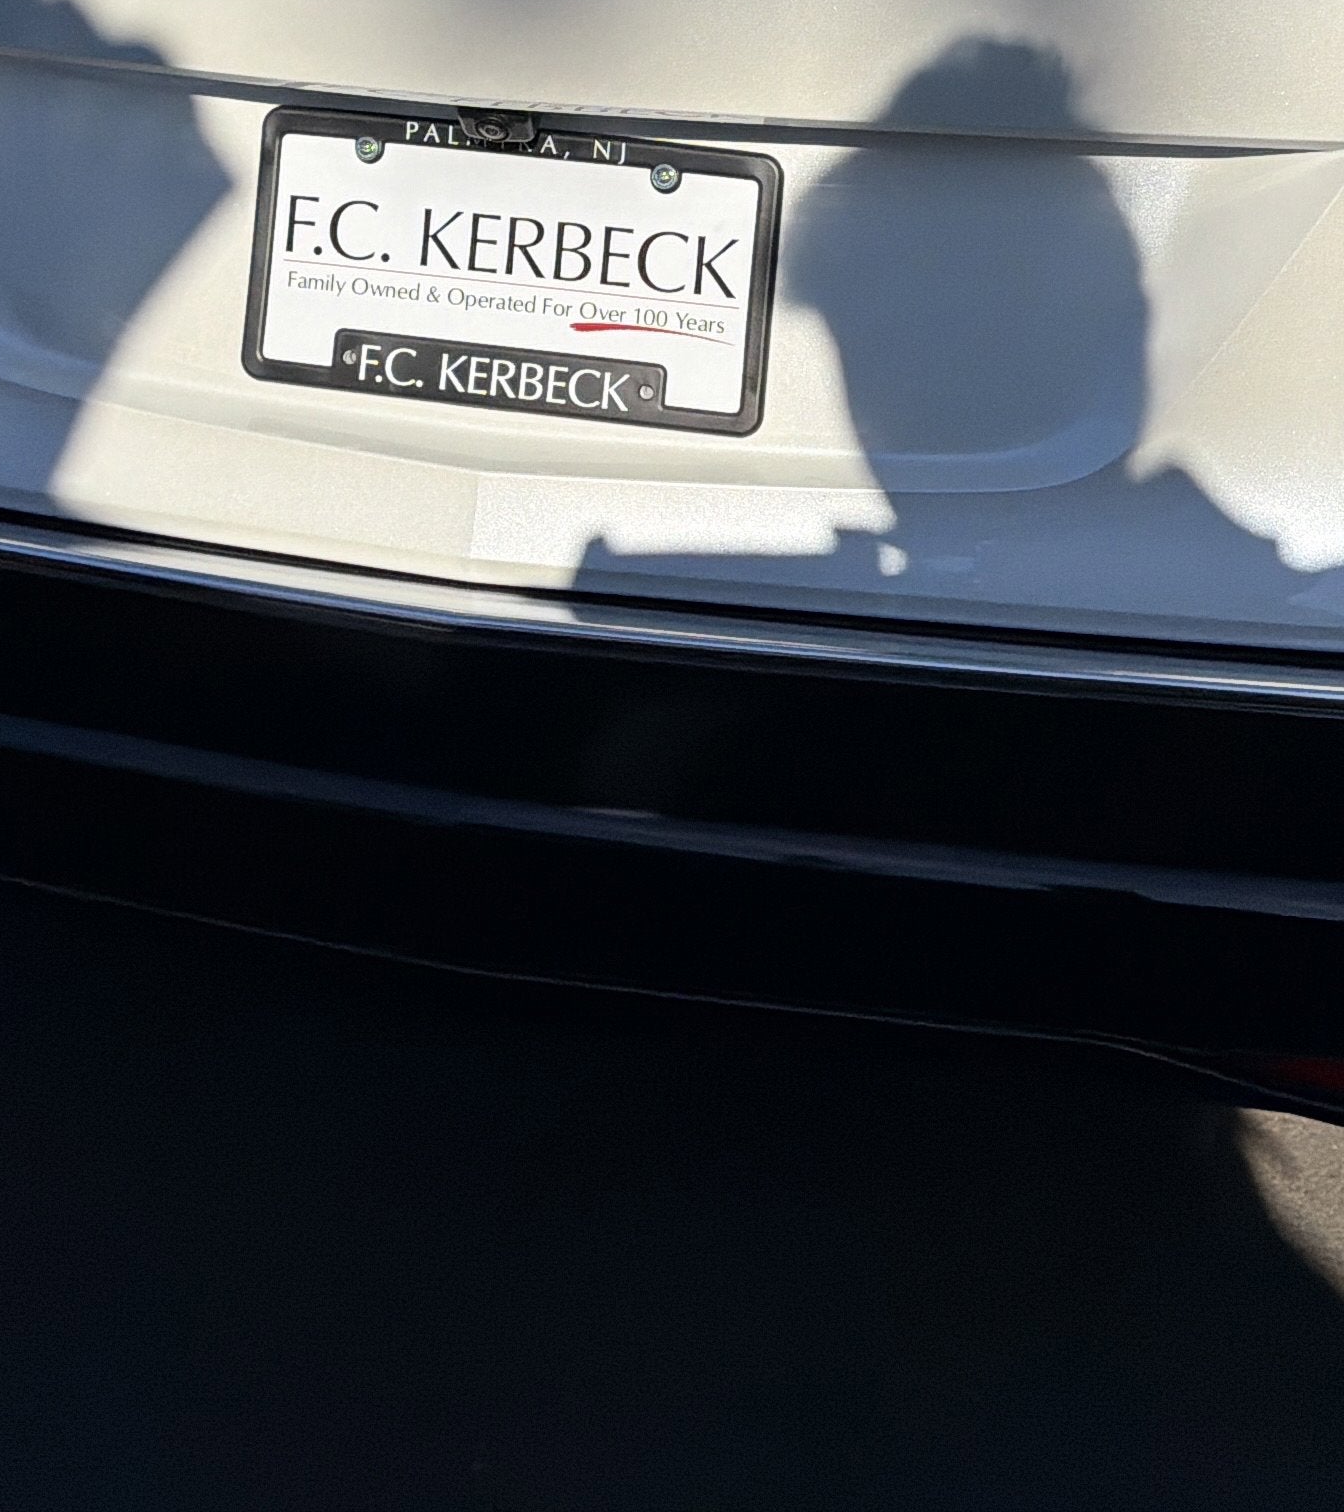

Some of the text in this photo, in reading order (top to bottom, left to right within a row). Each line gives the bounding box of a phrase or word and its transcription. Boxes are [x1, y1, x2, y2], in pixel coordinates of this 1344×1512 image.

[592, 138, 627, 165] NJ
[284, 193, 740, 300] F.C. KERBECK
[287, 270, 726, 335] Family Owned & Operated For Over 100 Years
[357, 343, 631, 413] F.C. KERBECK
